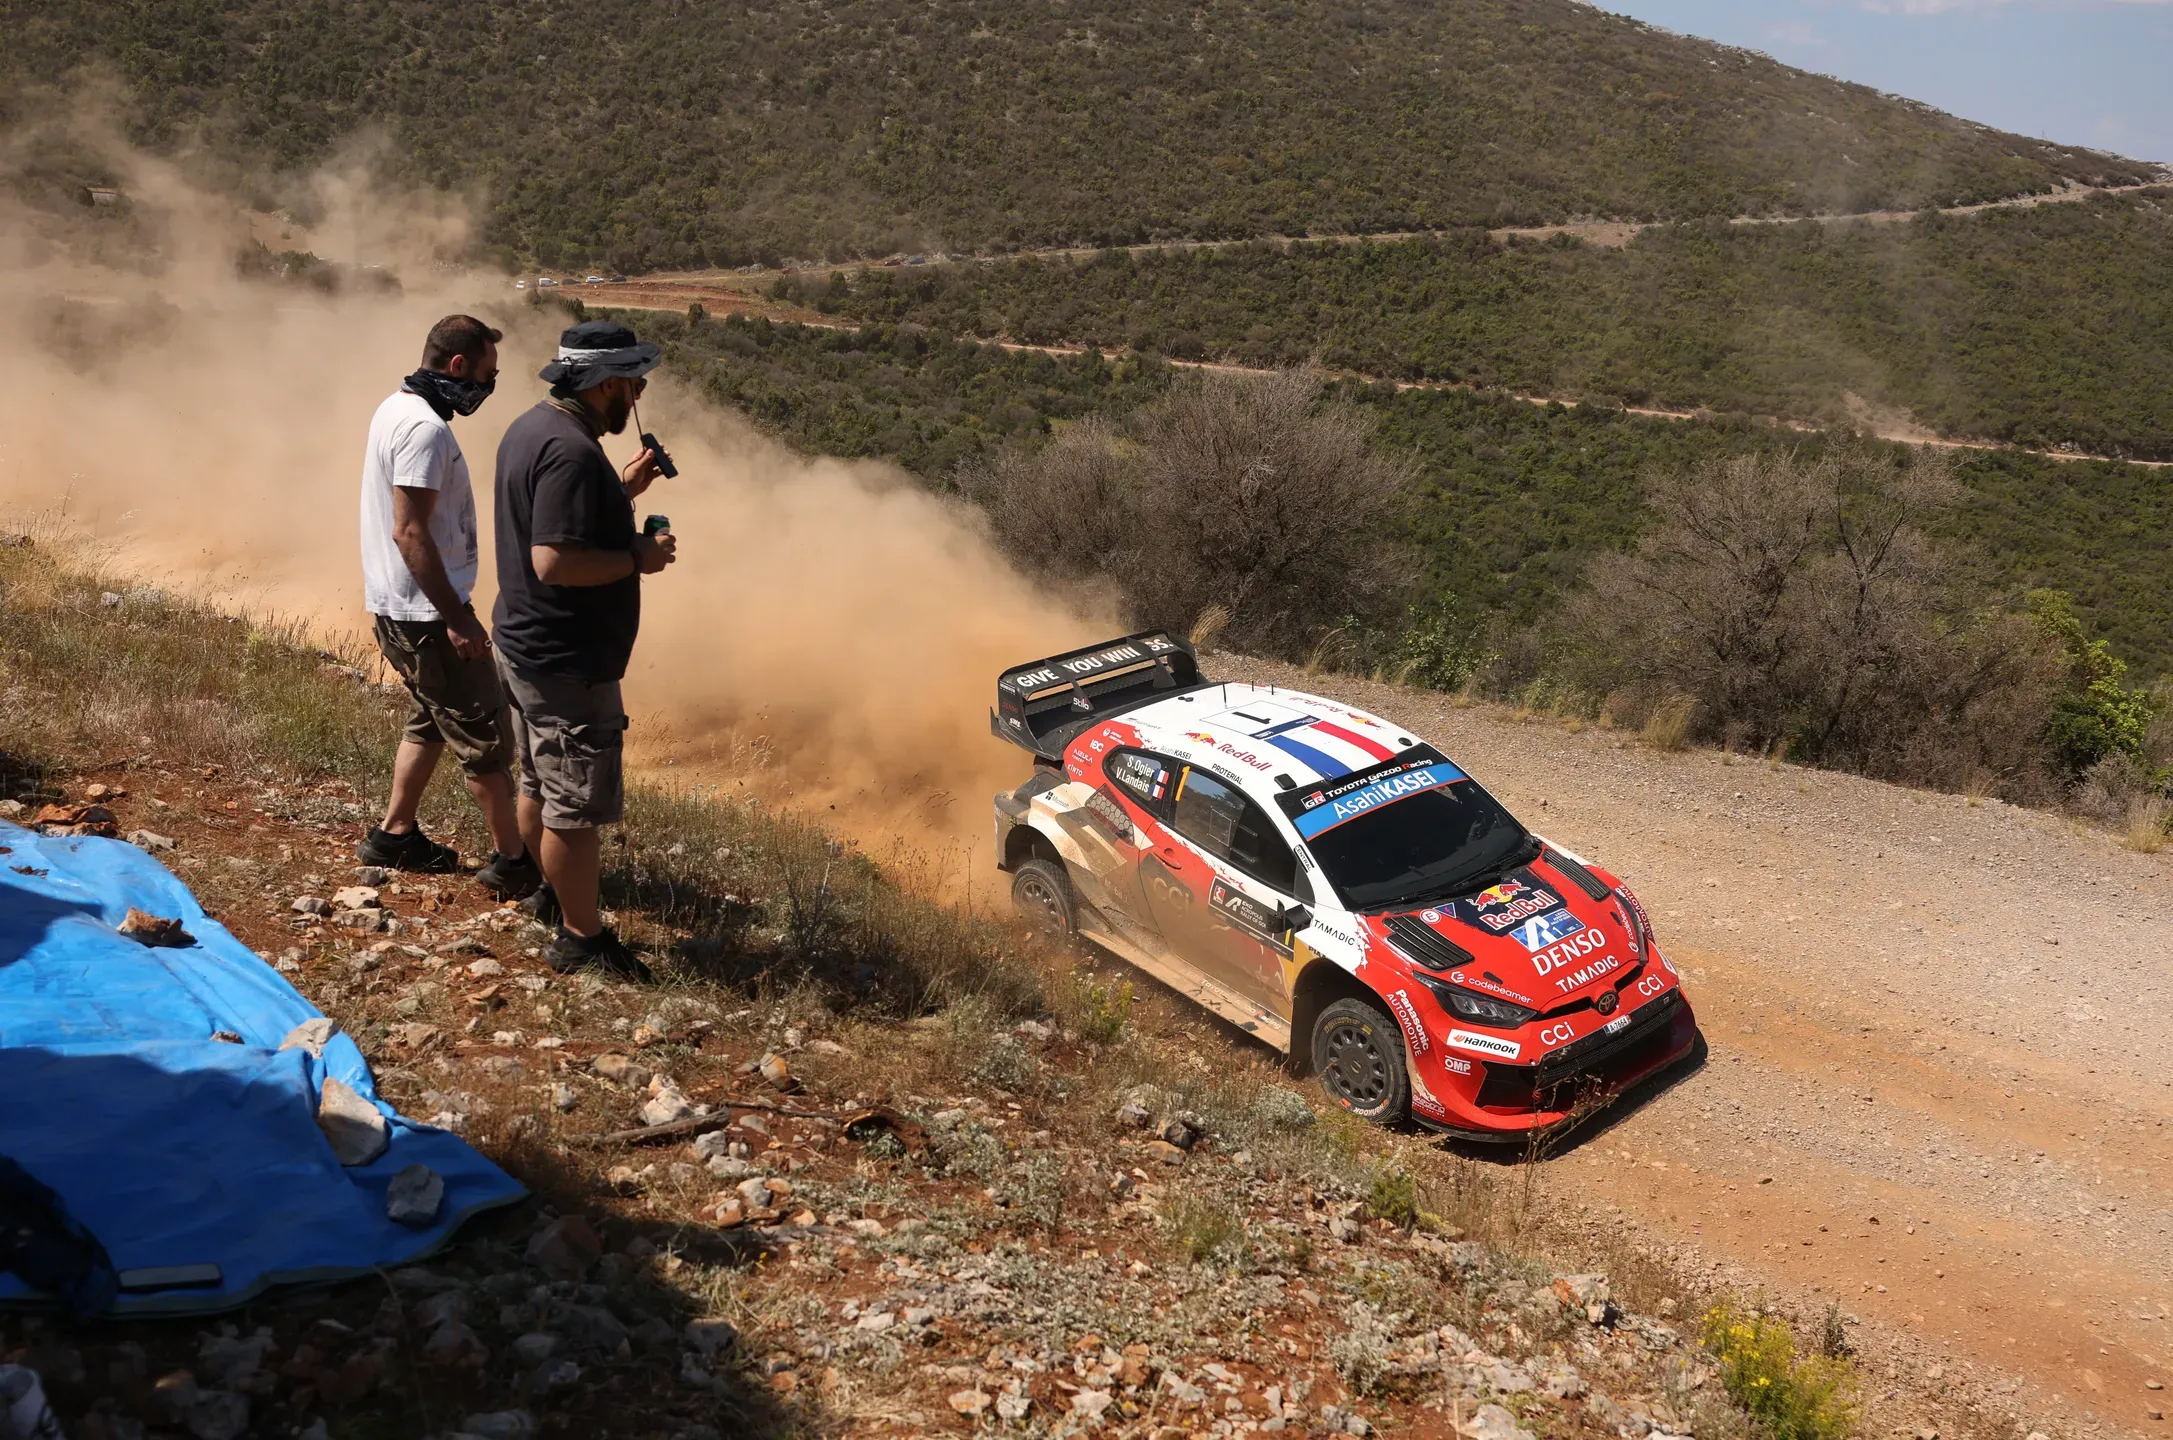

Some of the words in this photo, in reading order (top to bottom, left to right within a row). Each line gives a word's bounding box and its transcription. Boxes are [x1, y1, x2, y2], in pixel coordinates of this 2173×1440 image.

[1016, 669, 1059, 687] GIVE
[1063, 657, 1103, 674] YOU
[1100, 639, 1174, 663] WIIIGS.
[1231, 711, 1272, 725] 1
[1211, 763, 1243, 785] PROTERIAL
[1217, 743, 1249, 759] Red
[1240, 754, 1272, 771] Bull
[1325, 778, 1368, 798] TOYOTA
[1368, 766, 1402, 783] GAZOO
[1402, 759, 1433, 770] Racing
[1479, 902, 1528, 931] Red
[1512, 889, 1559, 915] Bull
[1313, 918, 1356, 946] TAMADIC
[1531, 928, 1606, 977] DENSO
[1468, 978, 1532, 1004] codebeamer
[1555, 955, 1619, 992] TAMADIC
[1386, 993, 1422, 1057] AUTOMOTIVE
[1395, 989, 1429, 1051] Panasonic
[1444, 1057, 1471, 1073] OMP
